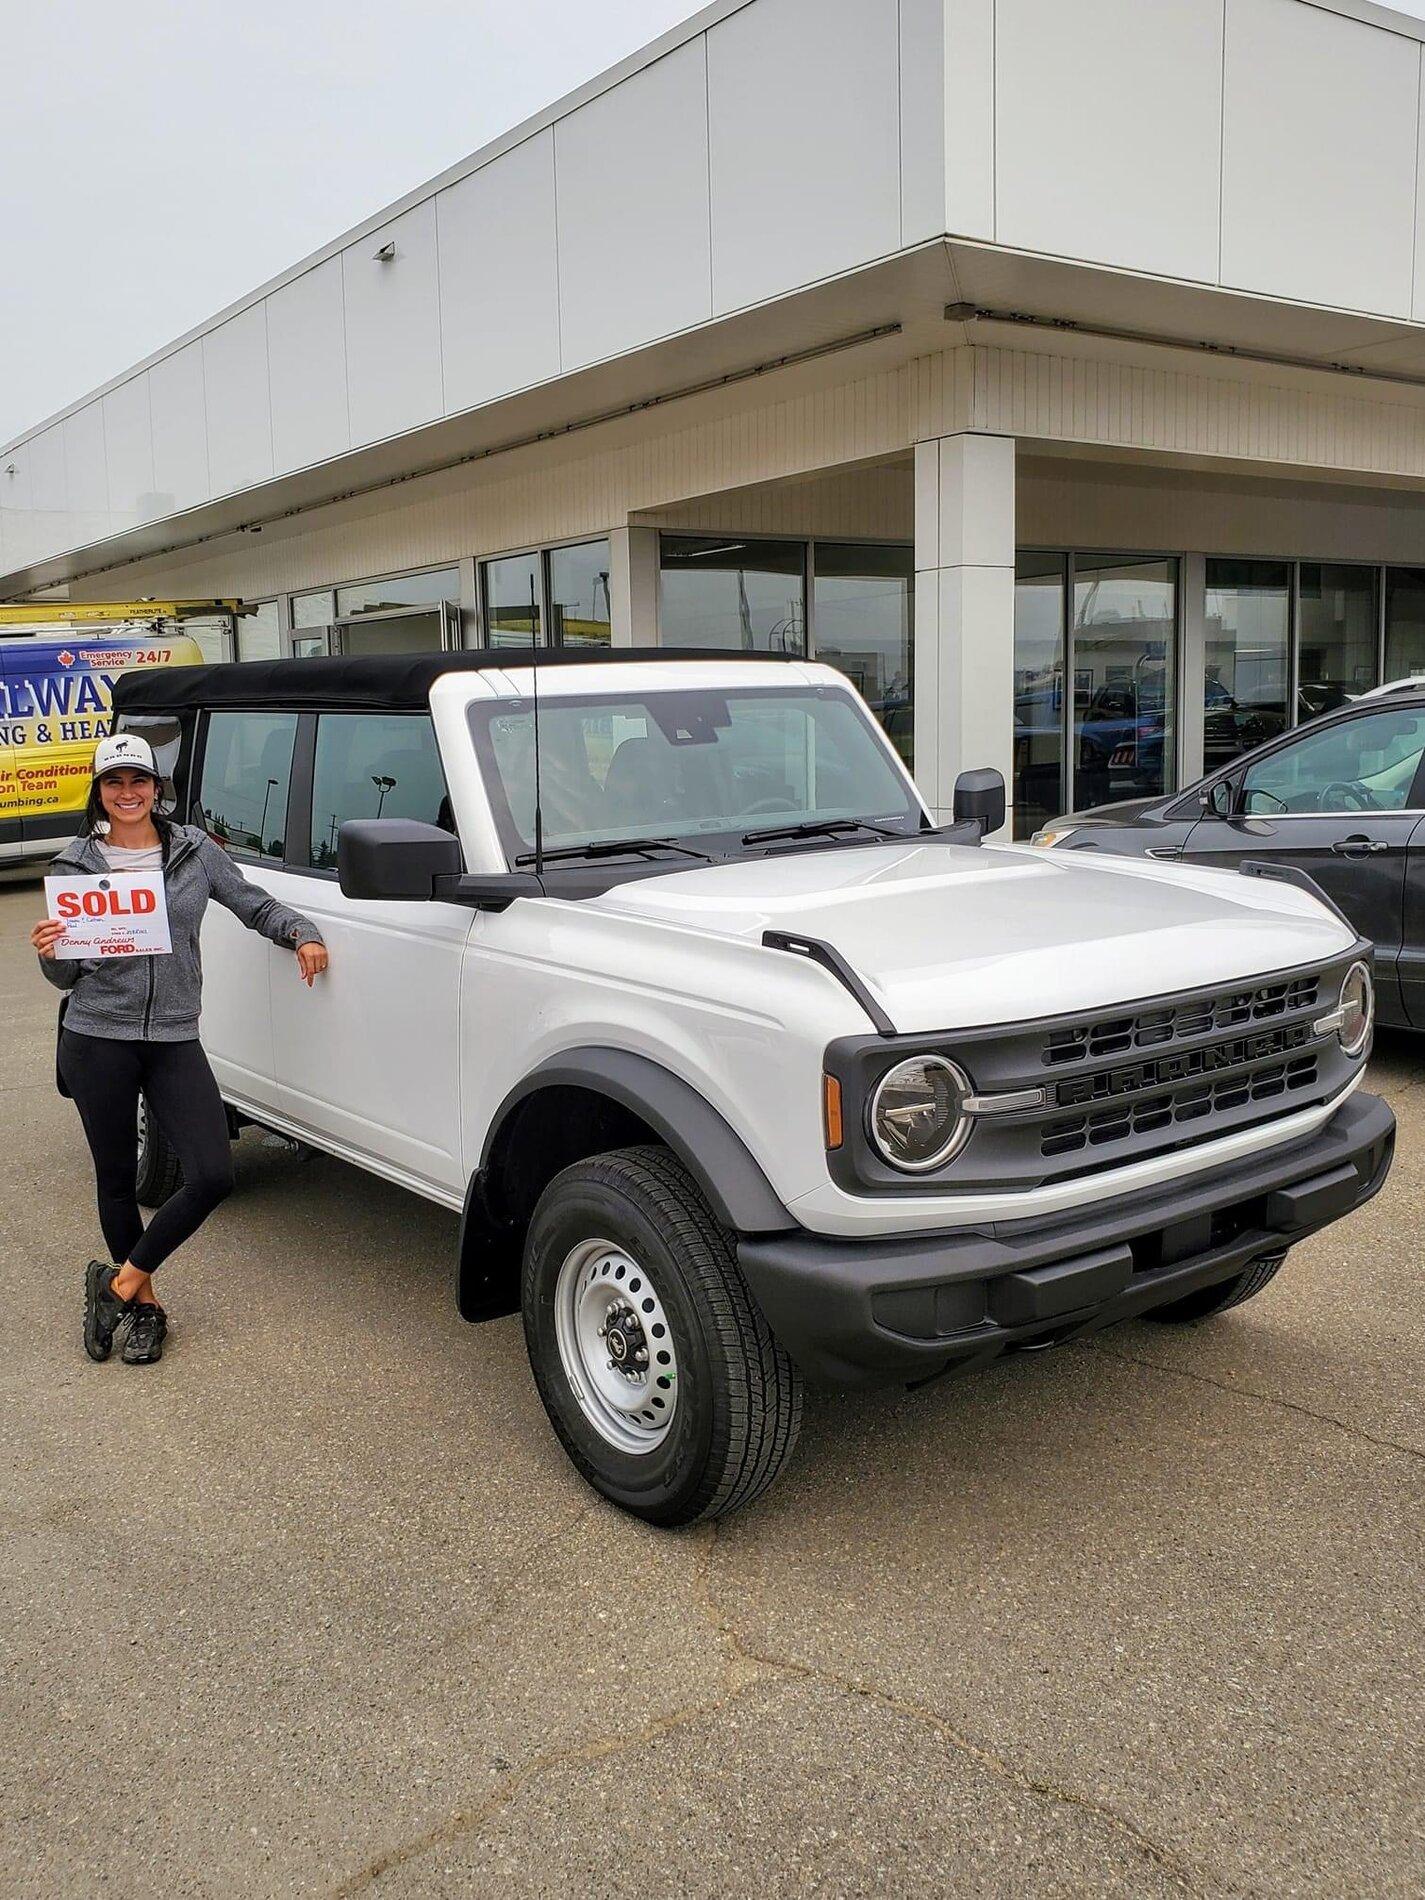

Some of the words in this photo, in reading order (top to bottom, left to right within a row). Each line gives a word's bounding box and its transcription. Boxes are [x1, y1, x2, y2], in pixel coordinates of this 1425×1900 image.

[80, 651, 132, 660] Emergency
[136, 650, 171, 663] 24/7
[91, 659, 125, 667] Service
[37, 723, 52, 742] &
[60, 719, 113, 741] HEA
[1, 770, 12, 782] ir
[20, 780, 57, 792] Team
[57, 889, 156, 918] SOLD
[60, 938, 91, 947] Denny
[100, 944, 135, 955] FORD
